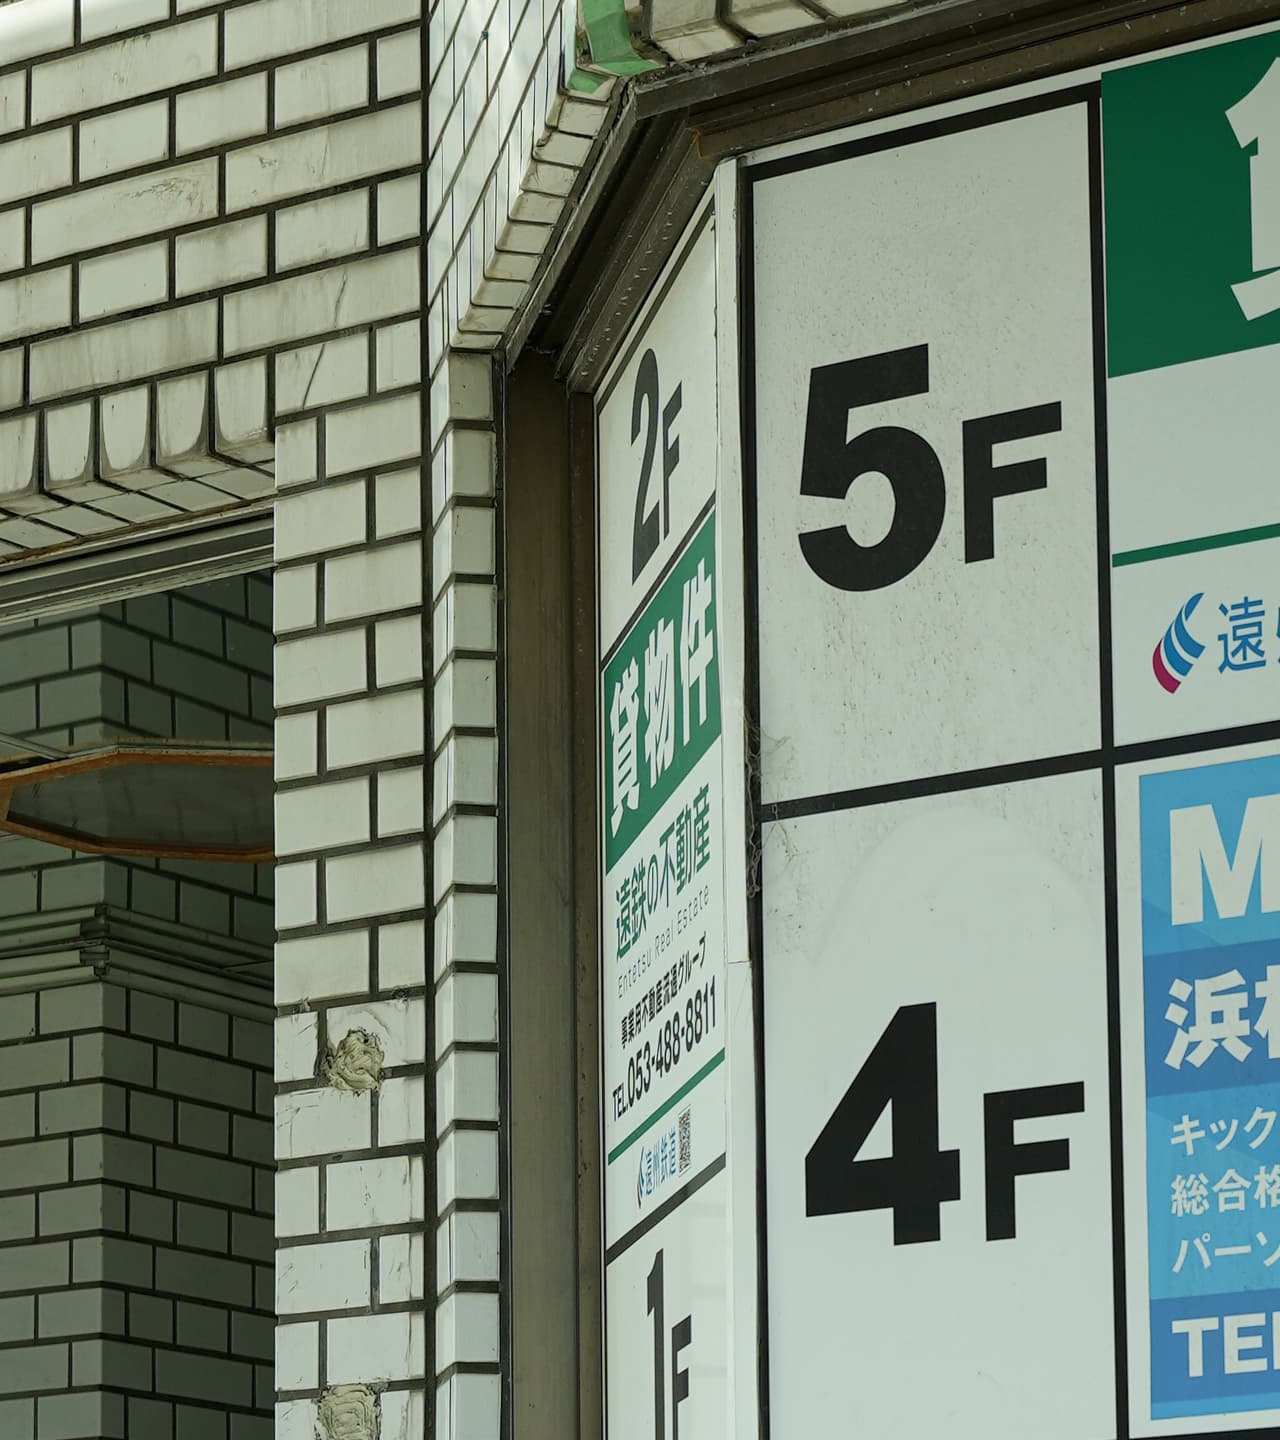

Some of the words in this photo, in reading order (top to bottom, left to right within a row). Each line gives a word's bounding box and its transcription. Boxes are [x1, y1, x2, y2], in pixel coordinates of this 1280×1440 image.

[631, 348, 682, 586] 2F
[798, 343, 1062, 592] 5F
[609, 558, 714, 838] 貸物件
[616, 783, 710, 962] 遠鉄の不動産
[618, 956, 652, 999] Entetsu
[655, 918, 675, 957] Real
[677, 884, 709, 935] Estate
[805, 1002, 1085, 1246] 4F
